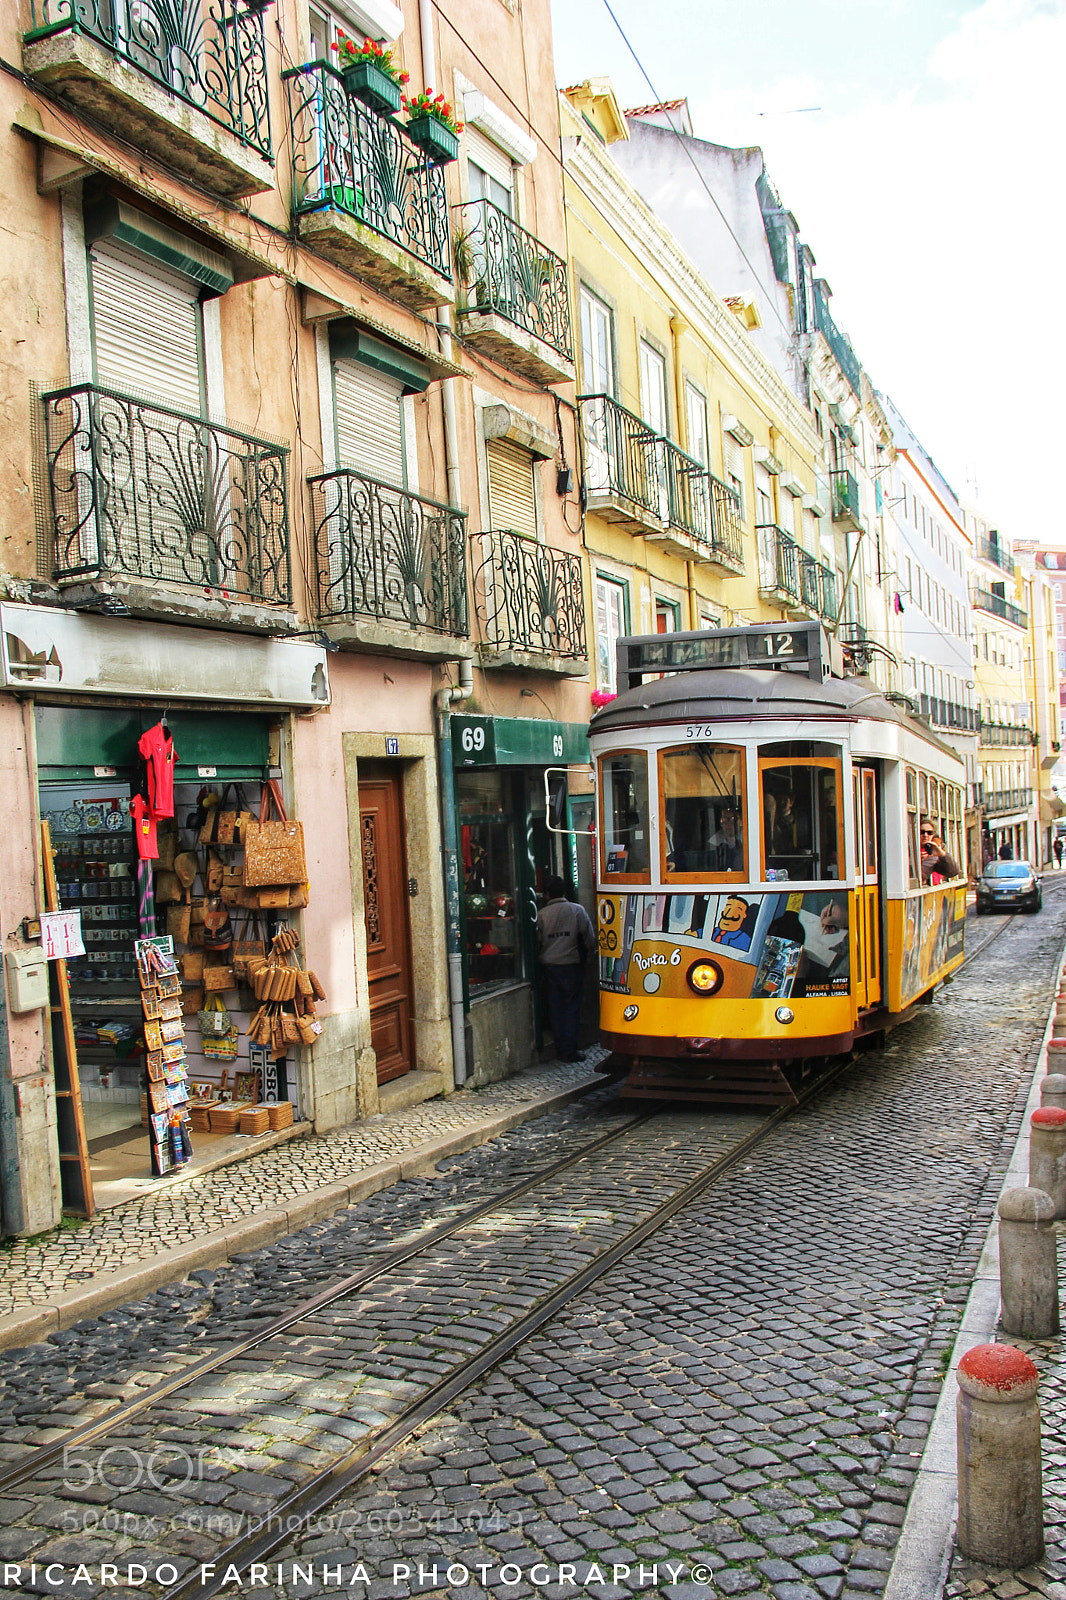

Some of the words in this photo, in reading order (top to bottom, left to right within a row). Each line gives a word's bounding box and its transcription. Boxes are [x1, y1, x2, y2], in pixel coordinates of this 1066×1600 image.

[763, 632, 794, 656] 12
[462, 727, 485, 752] 69
[686, 725, 712, 738] 576
[387, 739, 397, 754] 67
[552, 735, 563, 756] 69
[632, 951, 668, 971] Porta
[670, 947, 681, 966] 6
